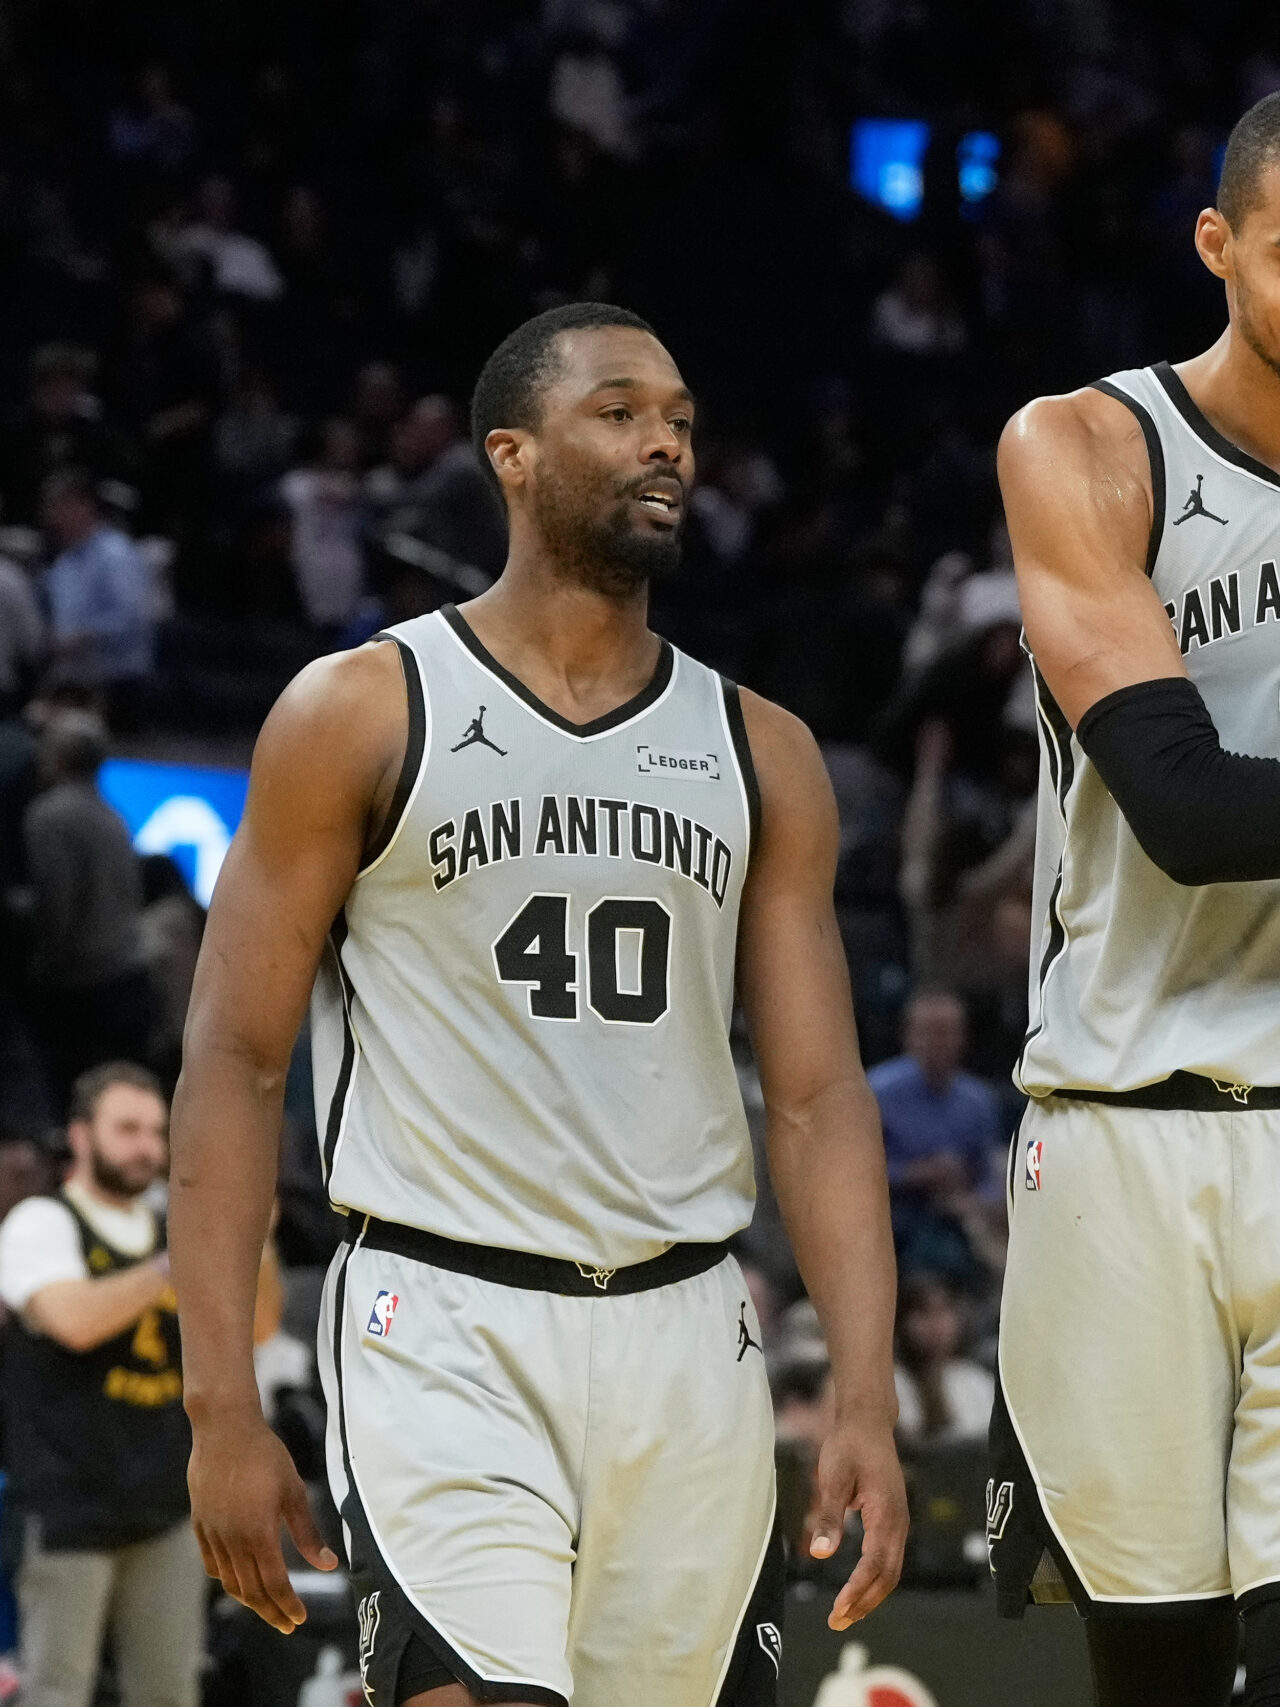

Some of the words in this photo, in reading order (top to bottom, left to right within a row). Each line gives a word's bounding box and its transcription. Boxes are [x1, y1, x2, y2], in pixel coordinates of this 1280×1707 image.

[648, 752, 710, 773] LEDGER
[428, 797, 523, 894] SAN
[532, 794, 733, 913] ANTONIO
[490, 891, 674, 1027] 40
